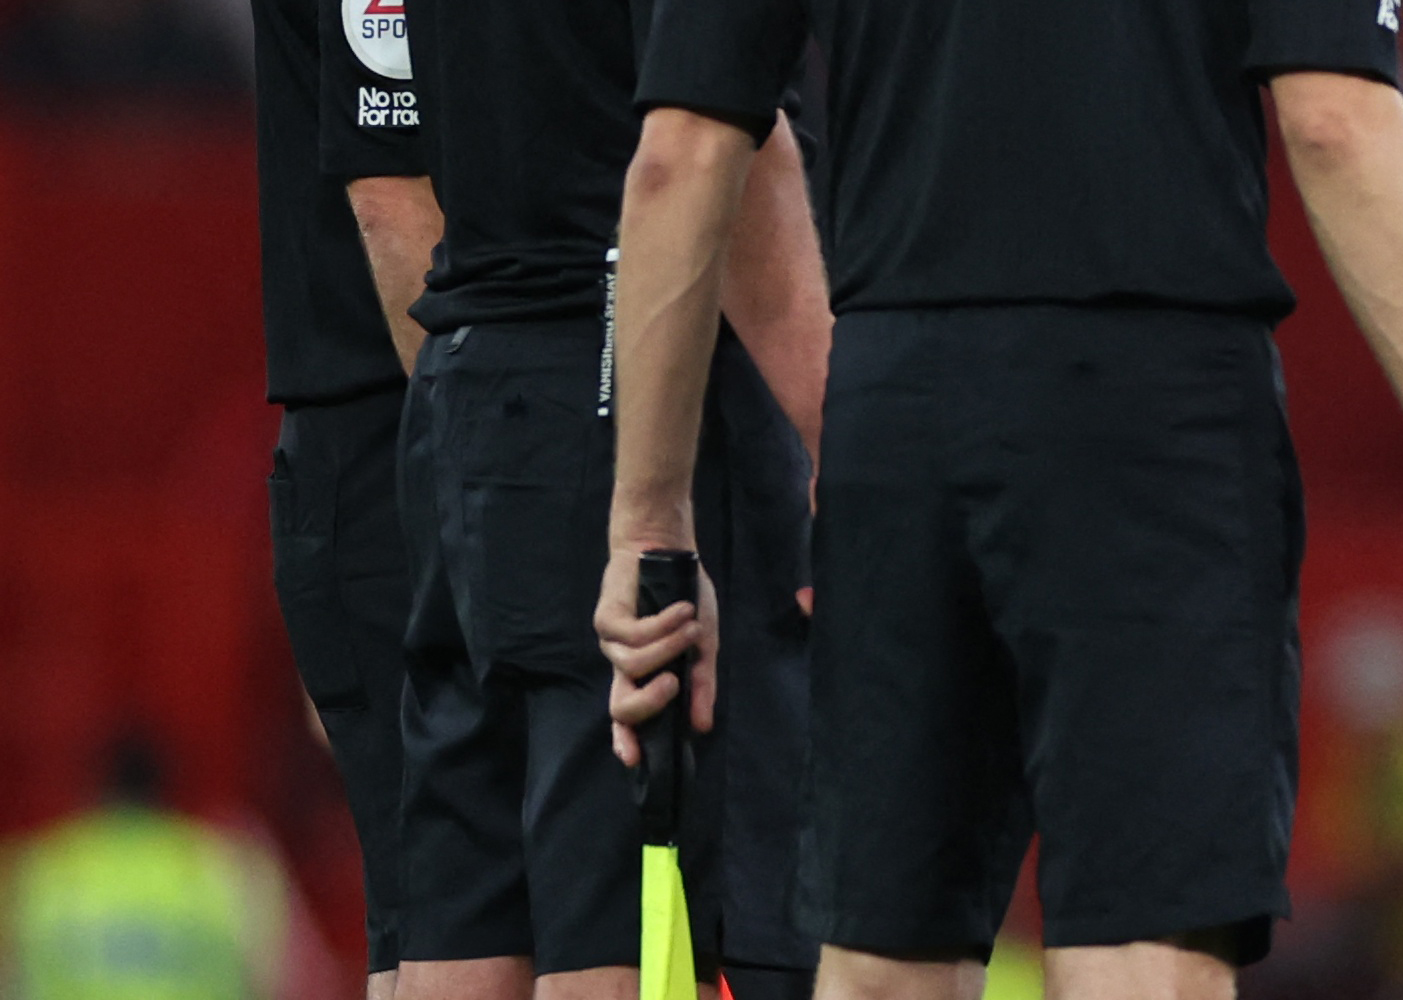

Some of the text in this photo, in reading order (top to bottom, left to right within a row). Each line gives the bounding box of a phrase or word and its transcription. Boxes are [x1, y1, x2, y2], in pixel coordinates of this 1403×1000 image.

[361, 18, 407, 39] SPO
[359, 86, 417, 108] No ro
